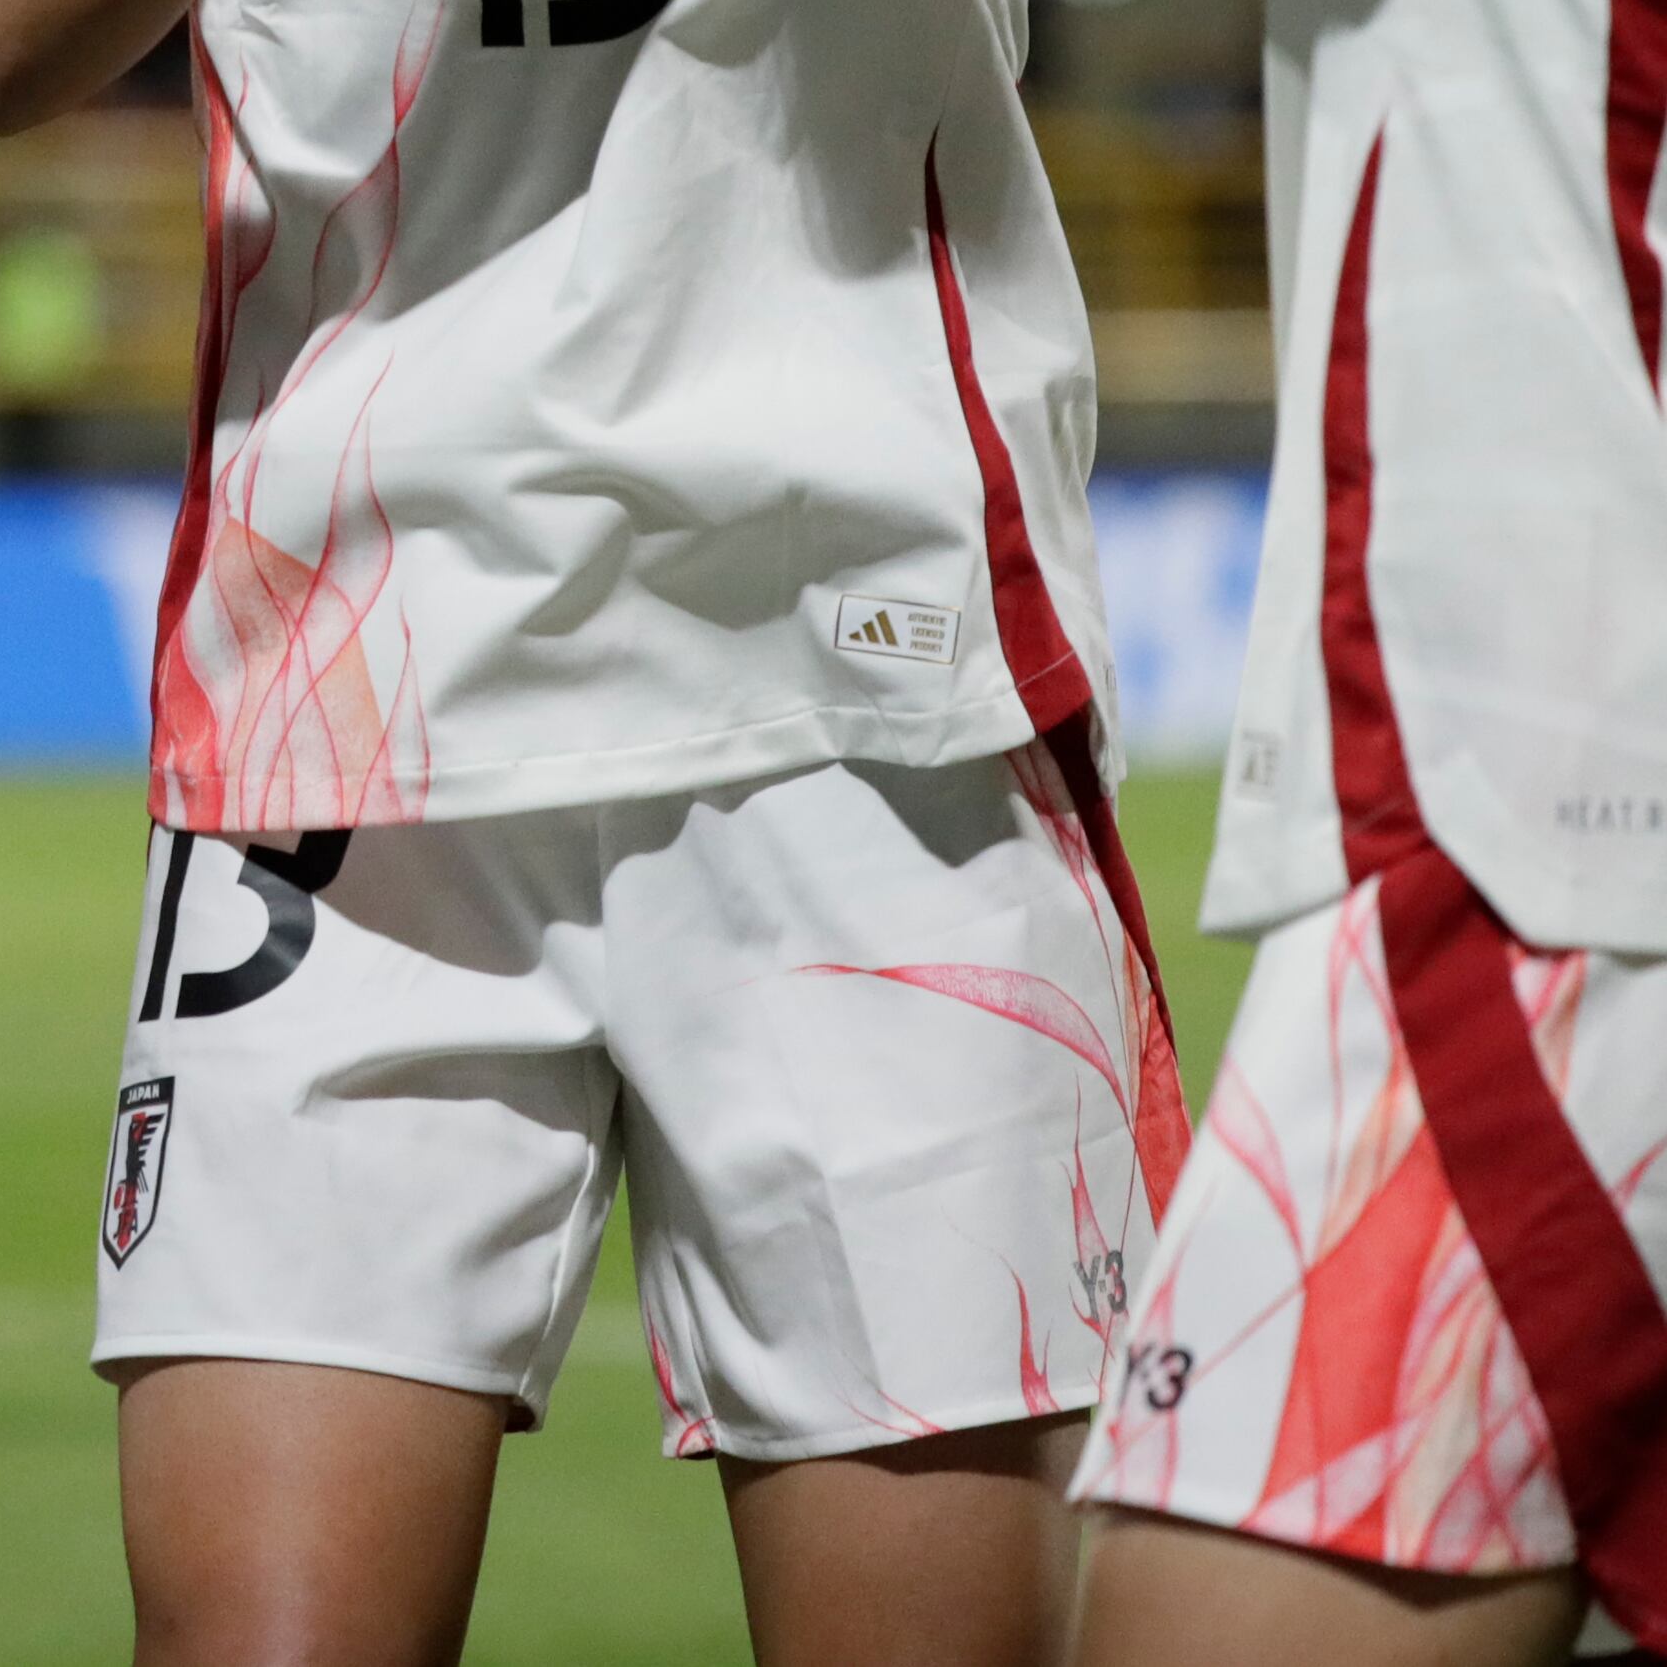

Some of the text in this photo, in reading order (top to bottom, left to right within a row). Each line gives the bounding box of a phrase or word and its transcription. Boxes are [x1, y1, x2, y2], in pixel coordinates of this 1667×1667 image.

[138, 829, 353, 1023] 13
[126, 1082, 160, 1105] JAPAN
[1073, 1249, 1127, 1323] Y-3
